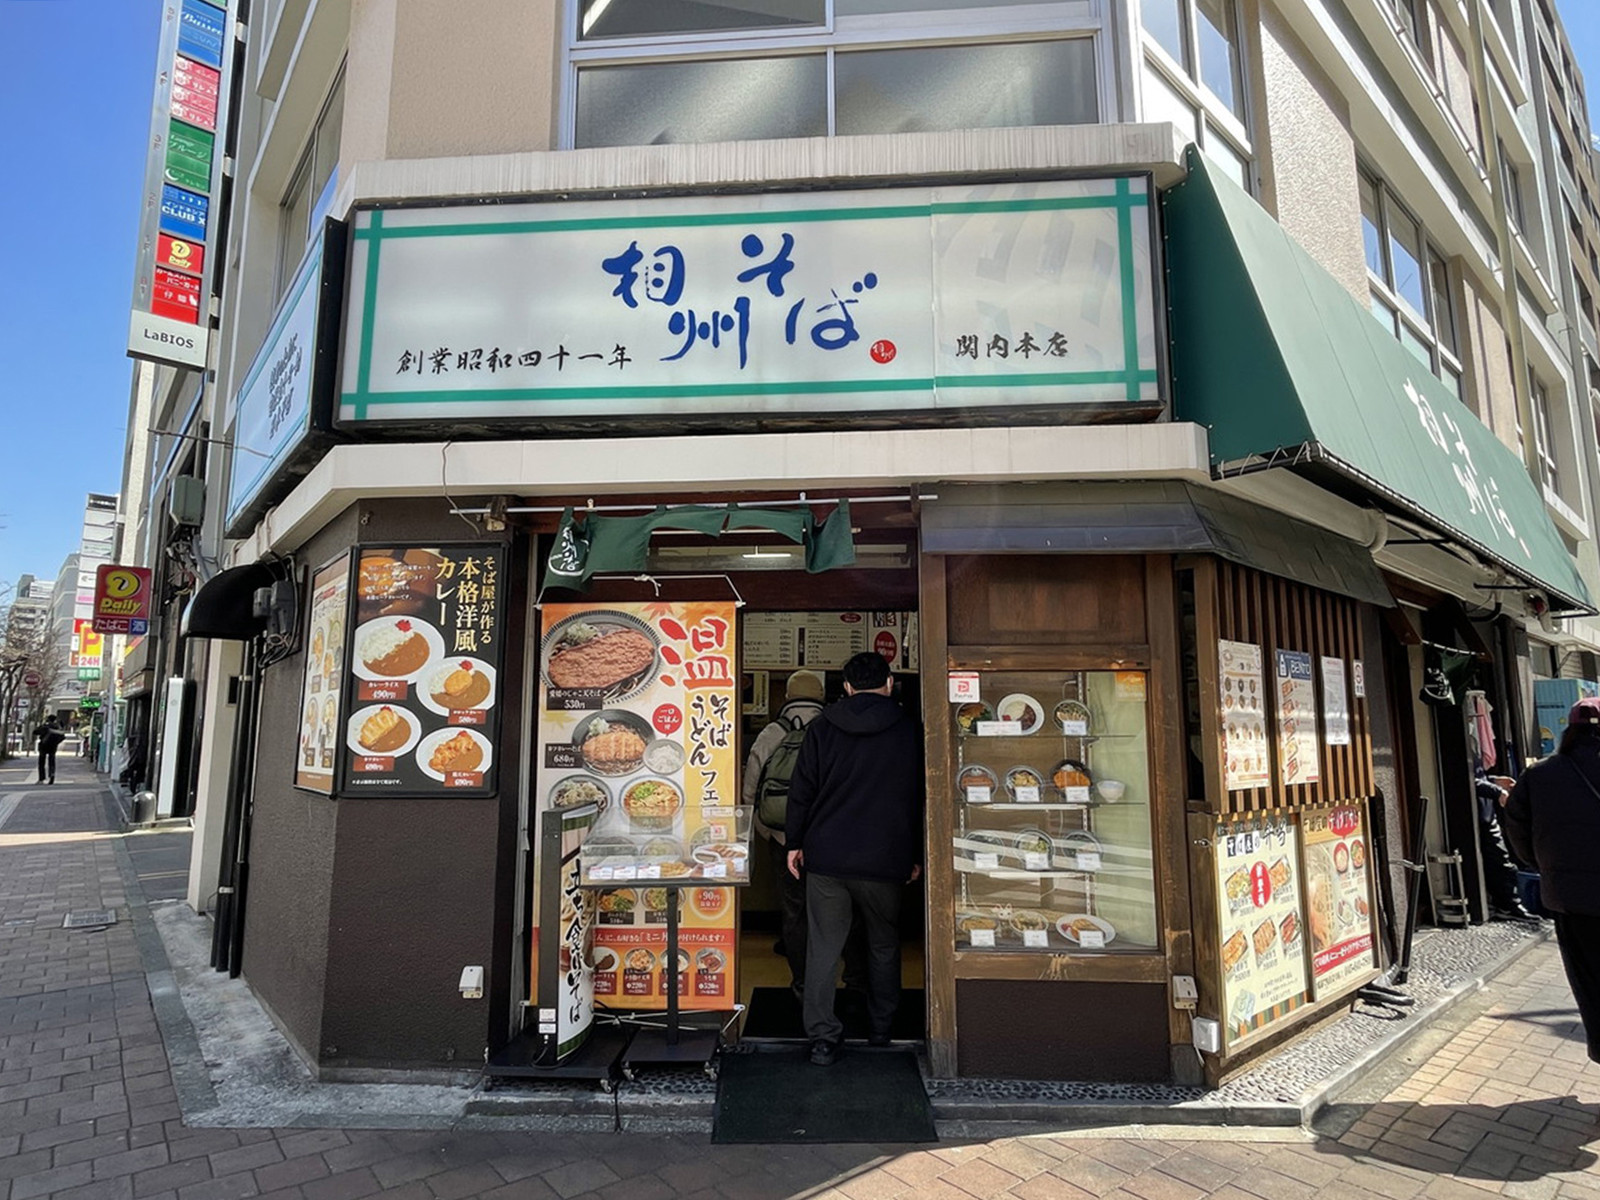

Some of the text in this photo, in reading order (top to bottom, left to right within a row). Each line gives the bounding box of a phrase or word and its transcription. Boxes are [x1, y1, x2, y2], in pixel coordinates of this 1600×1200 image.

[161, 205, 195, 222] CLUB
[144, 328, 194, 349] LaBIOS
[955, 331, 1068, 360] 関内本店
[396, 342, 632, 376] 創業昭和四十一年
[101, 598, 142, 615] Daily
[434, 556, 456, 626] カレー
[453, 556, 481, 652] 本格洋風
[480, 556, 497, 644] そば屋が作る
[94, 619, 146, 632] たばこ 酒
[80, 656, 100, 666] 24H
[659, 618, 734, 690] 温
[657, 715, 679, 723] ごはん
[689, 695, 711, 767] うどん
[710, 694, 732, 748] そば
[701, 771, 719, 806] フェ
